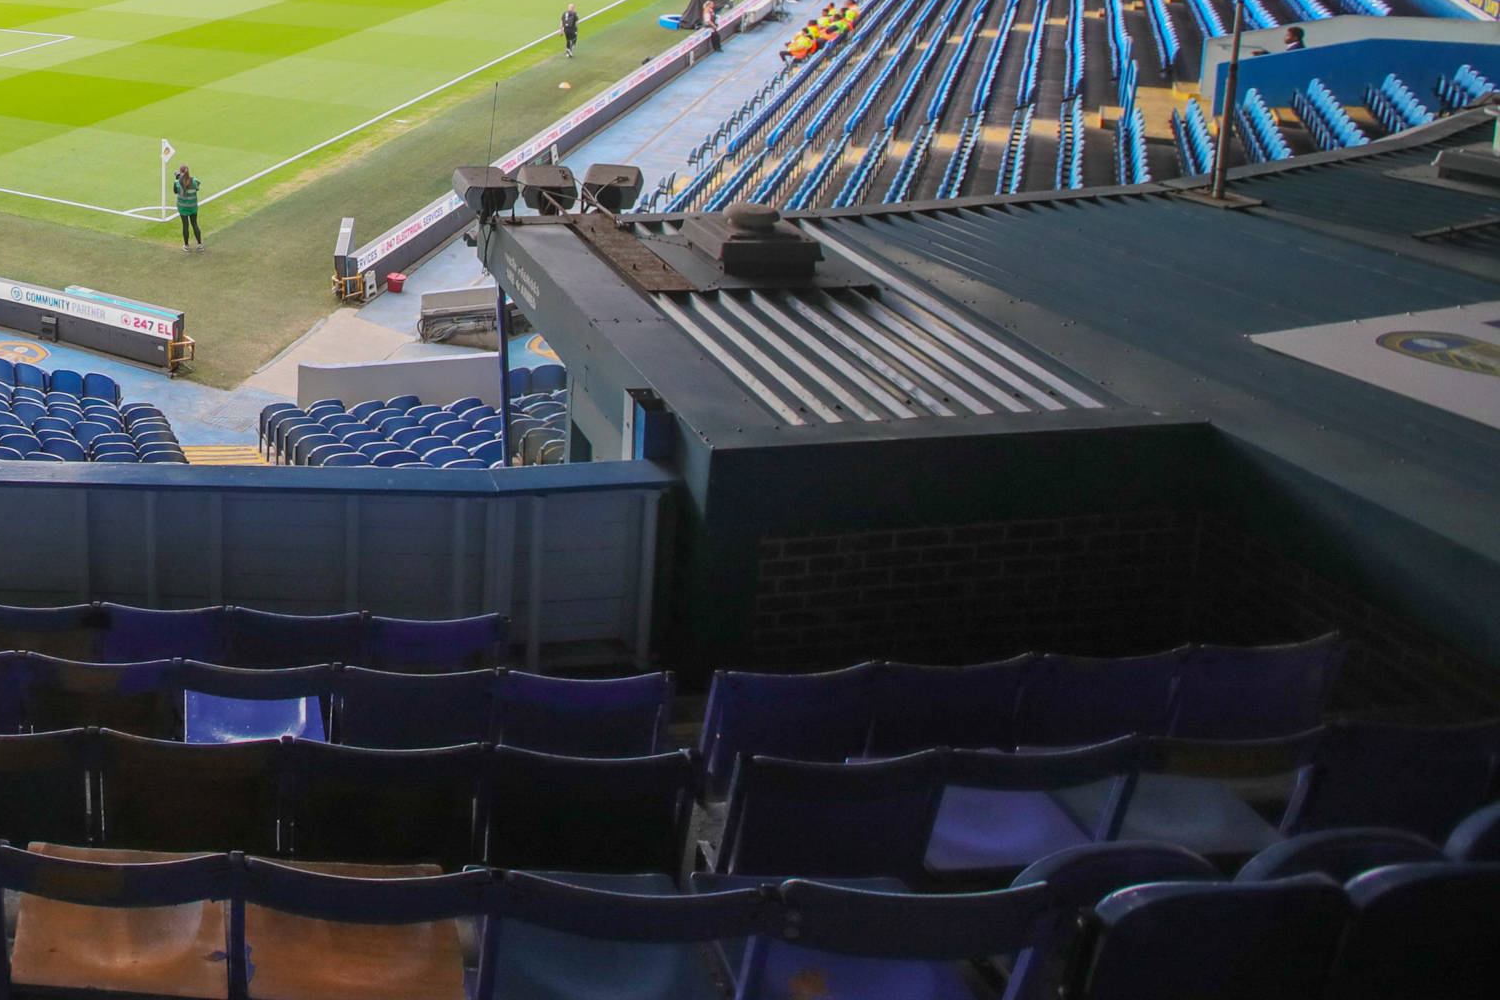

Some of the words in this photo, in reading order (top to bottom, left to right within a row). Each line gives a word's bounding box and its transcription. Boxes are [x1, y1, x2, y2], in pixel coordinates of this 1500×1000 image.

[423, 207, 444, 227] SERVICES
[25, 291, 71, 312] COMMUNITY
[71, 302, 106, 320] PARTNER
[133, 316, 154, 331] 247
